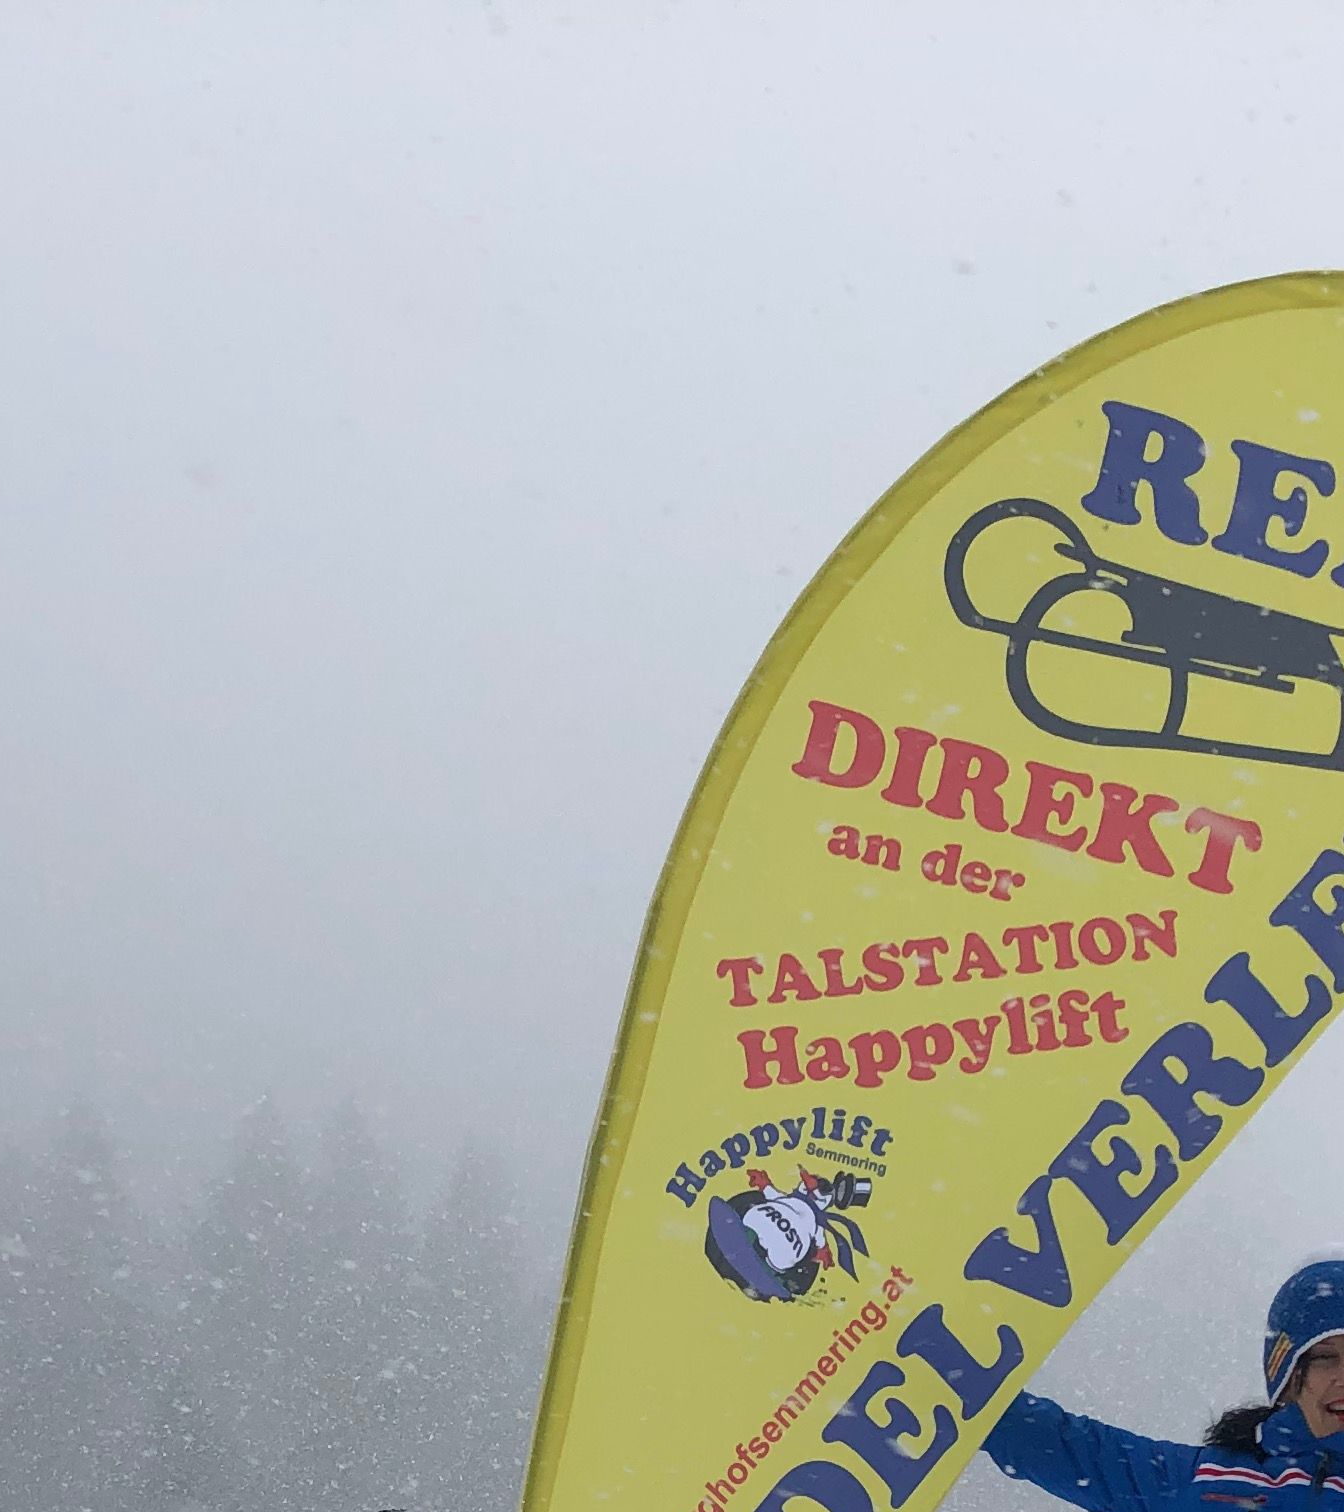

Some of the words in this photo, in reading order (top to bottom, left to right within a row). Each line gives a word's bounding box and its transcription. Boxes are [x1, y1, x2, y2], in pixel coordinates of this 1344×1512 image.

[791, 699, 1263, 895] DIREKT
[826, 823, 902, 872] an
[921, 843, 1026, 901] der
[716, 909, 1179, 1007] TALSTATION
[737, 989, 1130, 1089] Happylift
[665, 1106, 894, 1209] Happylift
[806, 1142, 887, 1177] Semmering
[757, 1204, 804, 1259] FROSTI
